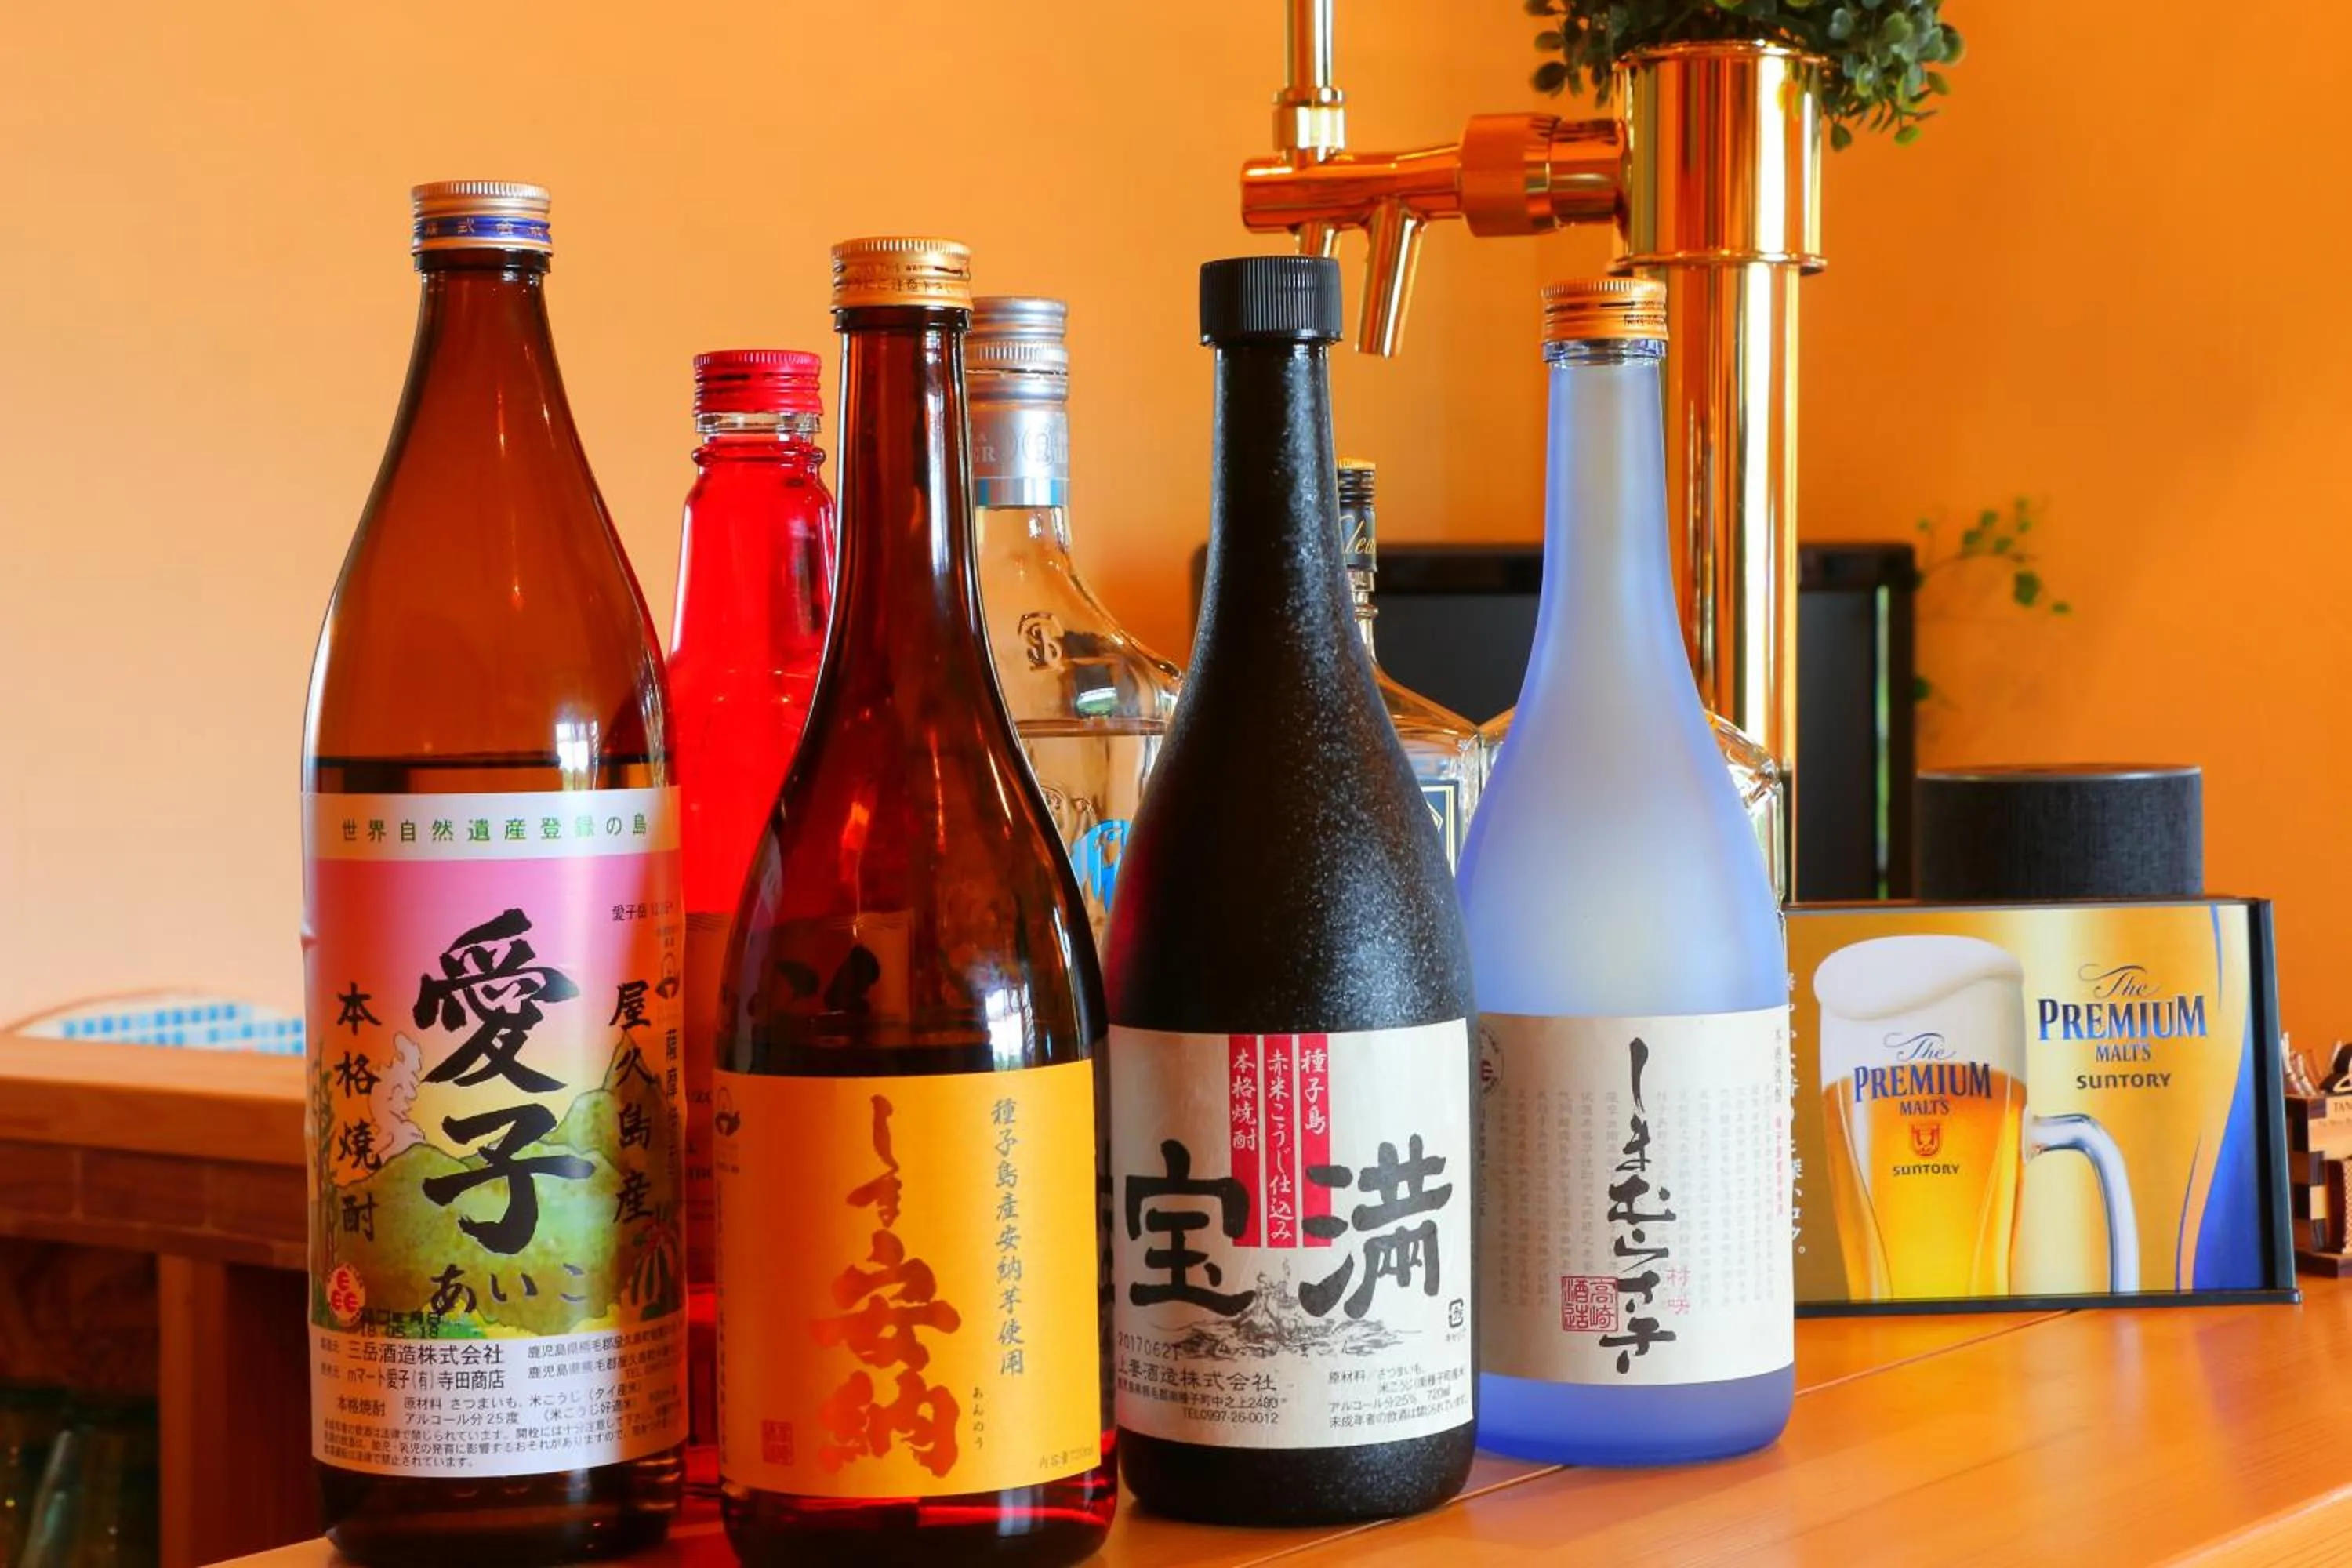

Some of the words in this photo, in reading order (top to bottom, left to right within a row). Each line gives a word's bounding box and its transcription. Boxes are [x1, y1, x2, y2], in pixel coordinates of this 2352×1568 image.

[342, 813, 648, 843] 世界自然遺産登録の島
[2078, 963, 2161, 1000] The
[2038, 994, 2208, 1041] PREMIUM
[1883, 1032, 1957, 1062] The
[2095, 1043, 2152, 1063] MALT'S
[412, 908, 597, 1255] 愛子
[608, 979, 656, 1225] 屋久島産
[1231, 1047, 1258, 1152] 本格焼酎
[1300, 1047, 1327, 1136] 種子島
[1853, 1061, 1993, 1103] PREMIUM
[2076, 1072, 2172, 1090] SUNTORY
[1900, 1099, 1951, 1117] MALT'S
[1266, 1047, 1294, 1240] 赤米こうじ仕込み
[1892, 1163, 1960, 1177] SUNTORY
[992, 1098, 1025, 1376] 種子島産安納芋使用
[1126, 1134, 1454, 1320] 宝満
[430, 1263, 587, 1313] あいこ
[347, 1340, 505, 1365] 三岳酒造株式会社
[971, 1386, 985, 1450] あんのう
